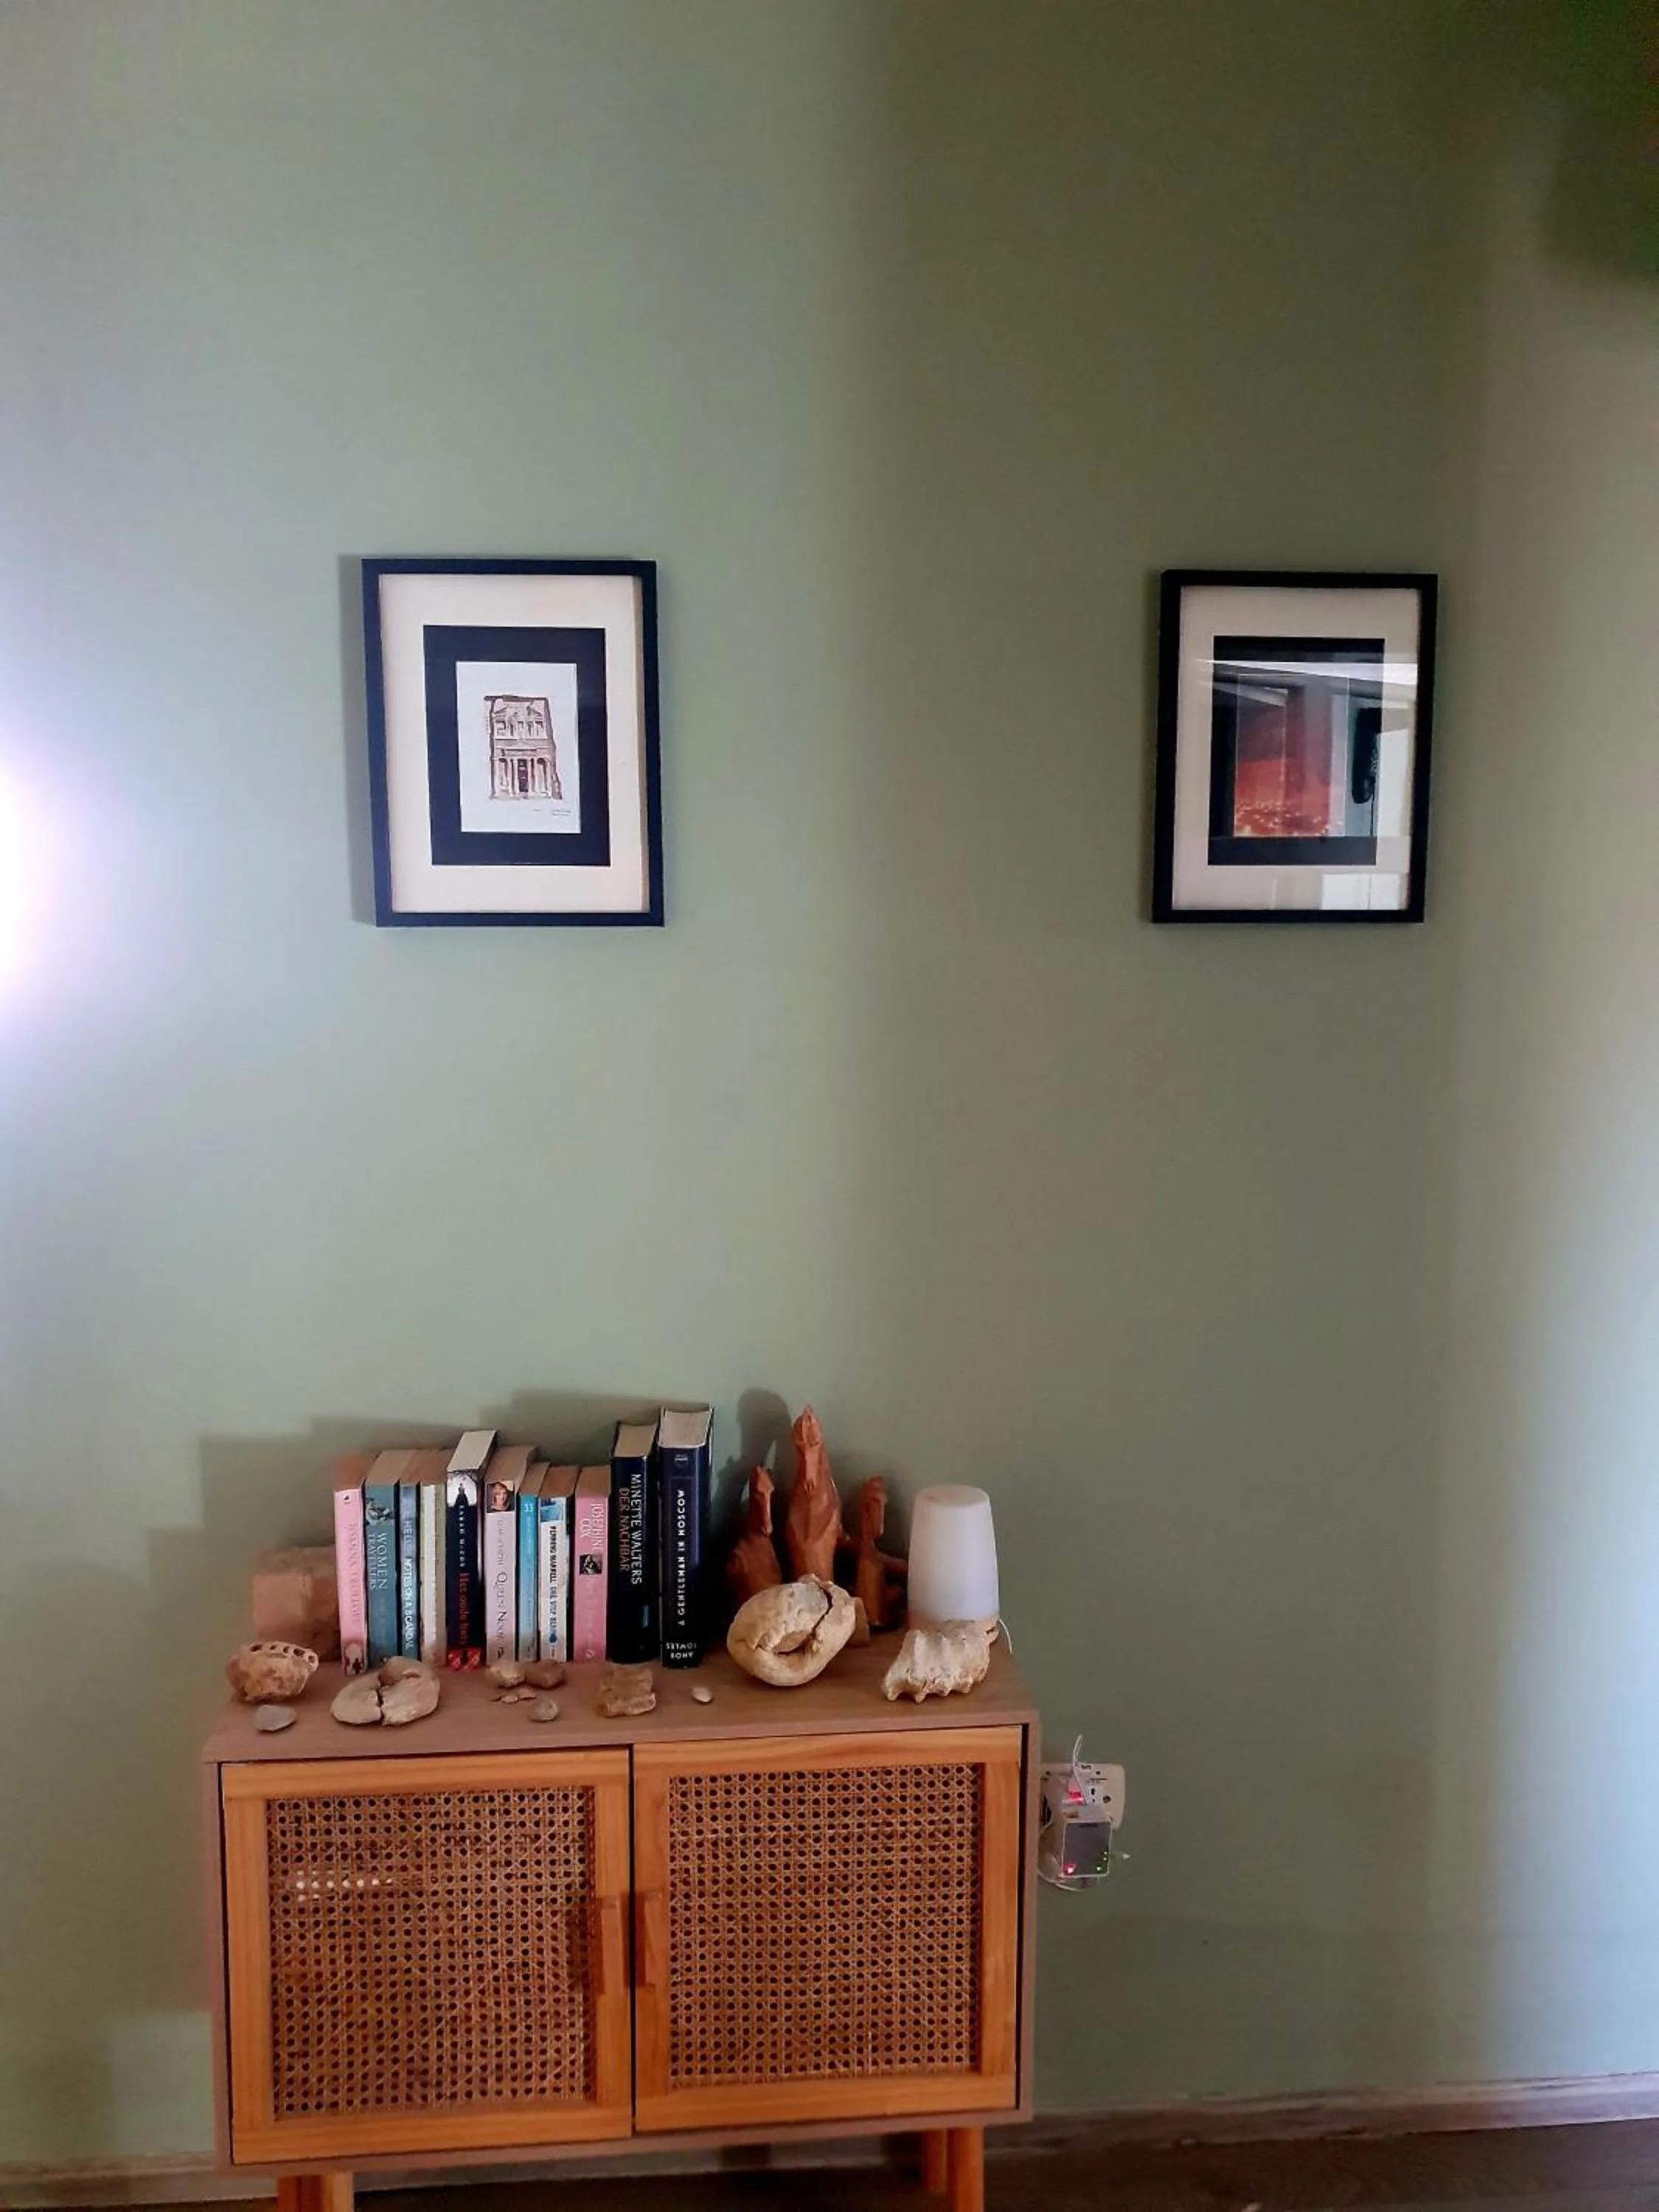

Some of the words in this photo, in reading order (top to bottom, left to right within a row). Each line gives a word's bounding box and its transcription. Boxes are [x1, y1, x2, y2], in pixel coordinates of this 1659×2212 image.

[619, 1487, 630, 1512] DER
[631, 1473, 643, 1527] MINETTE
[678, 1489, 686, 1536] MOSCOW
[377, 1532, 388, 1590] WOMEN
[619, 1514, 630, 1572] NACHBAR
[630, 1529, 642, 1585] WALTERS
[678, 1541, 685, 1551] IN
